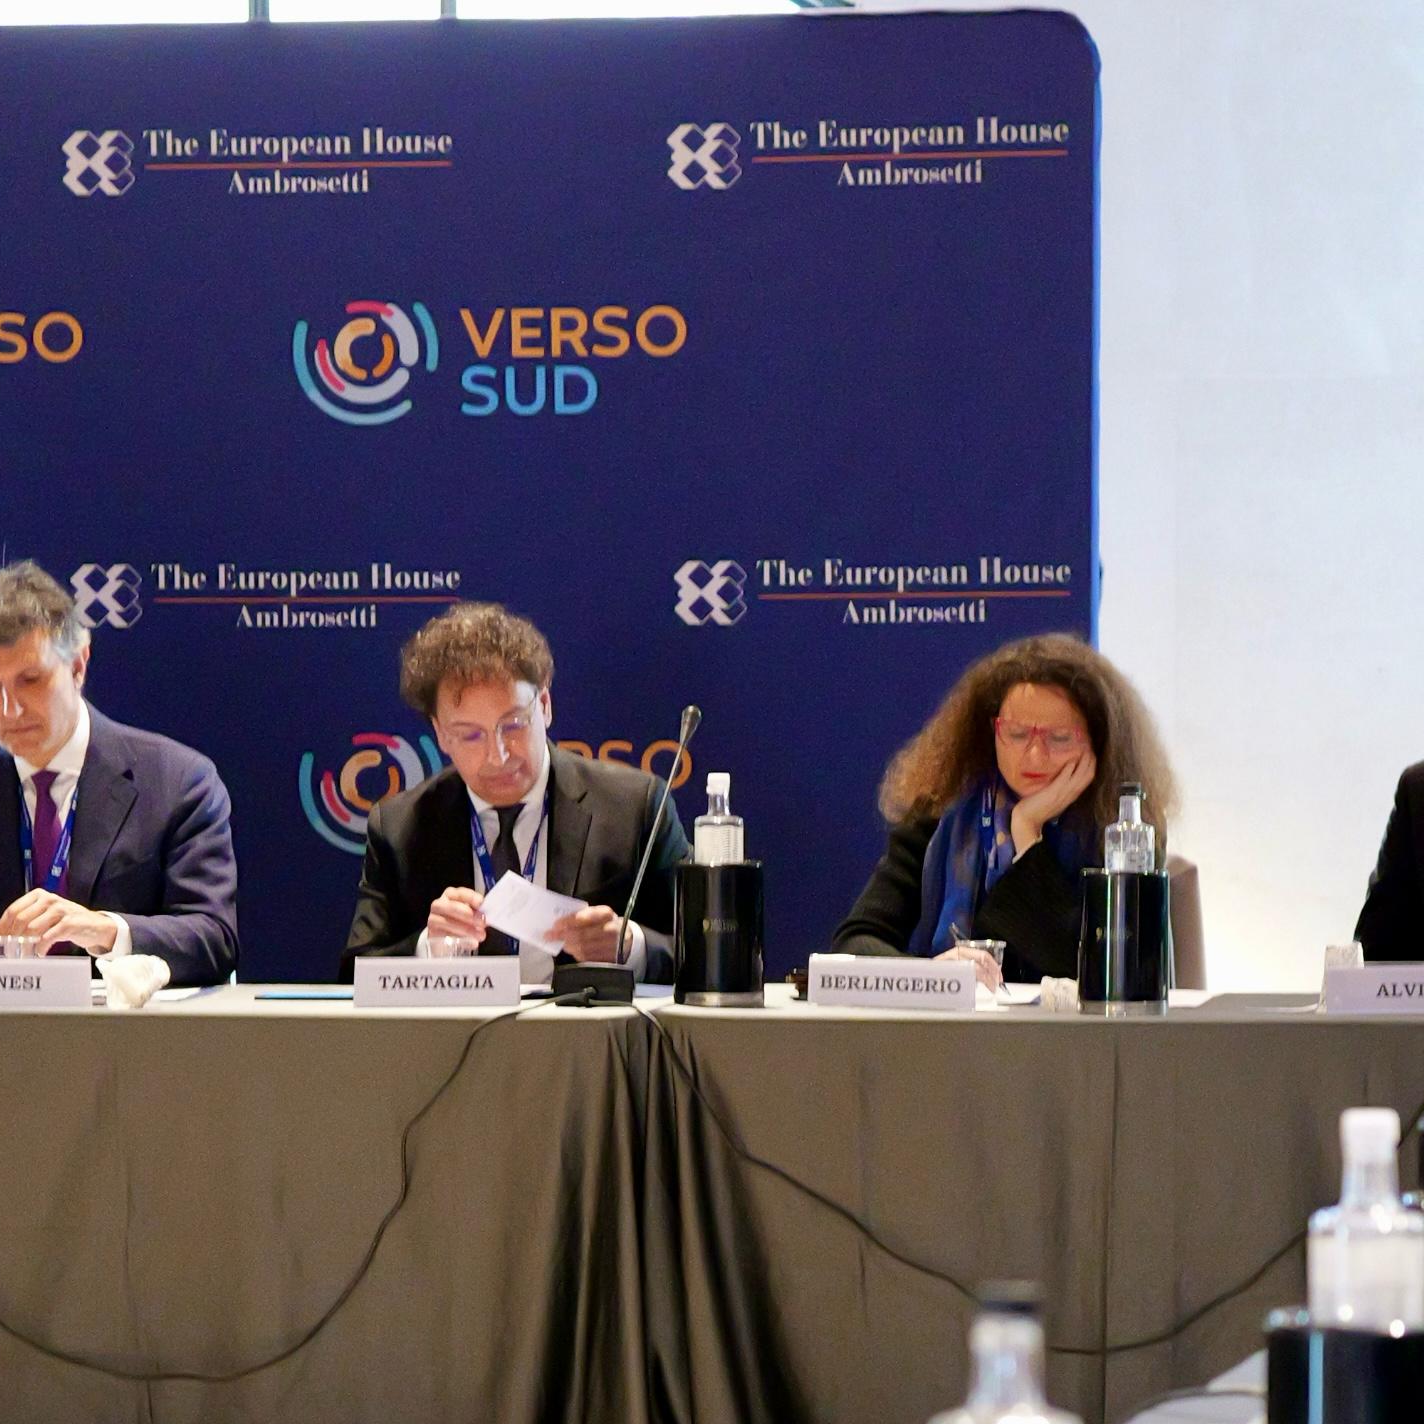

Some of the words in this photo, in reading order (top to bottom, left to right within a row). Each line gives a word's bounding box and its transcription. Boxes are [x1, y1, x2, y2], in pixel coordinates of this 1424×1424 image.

[142, 129, 199, 157] The
[210, 129, 351, 161] European
[362, 127, 453, 154] House
[749, 121, 807, 149] The
[818, 119, 964, 153] European
[976, 116, 1069, 144] House
[227, 167, 369, 194] Ambrosetti
[836, 160, 982, 187] Ambrosetti
[459, 305, 687, 358] VERSO
[461, 365, 598, 415] SUD
[150, 563, 207, 590] The
[218, 563, 359, 597] European
[371, 562, 461, 590] House
[755, 559, 813, 587] The
[824, 558, 968, 592] European
[980, 556, 1071, 584] House
[236, 604, 377, 628] Ambrosetti
[843, 599, 986, 624] Ambrosetti
[378, 974, 495, 991] TARTAGLIA
[819, 974, 963, 995] BERLINGERIO
